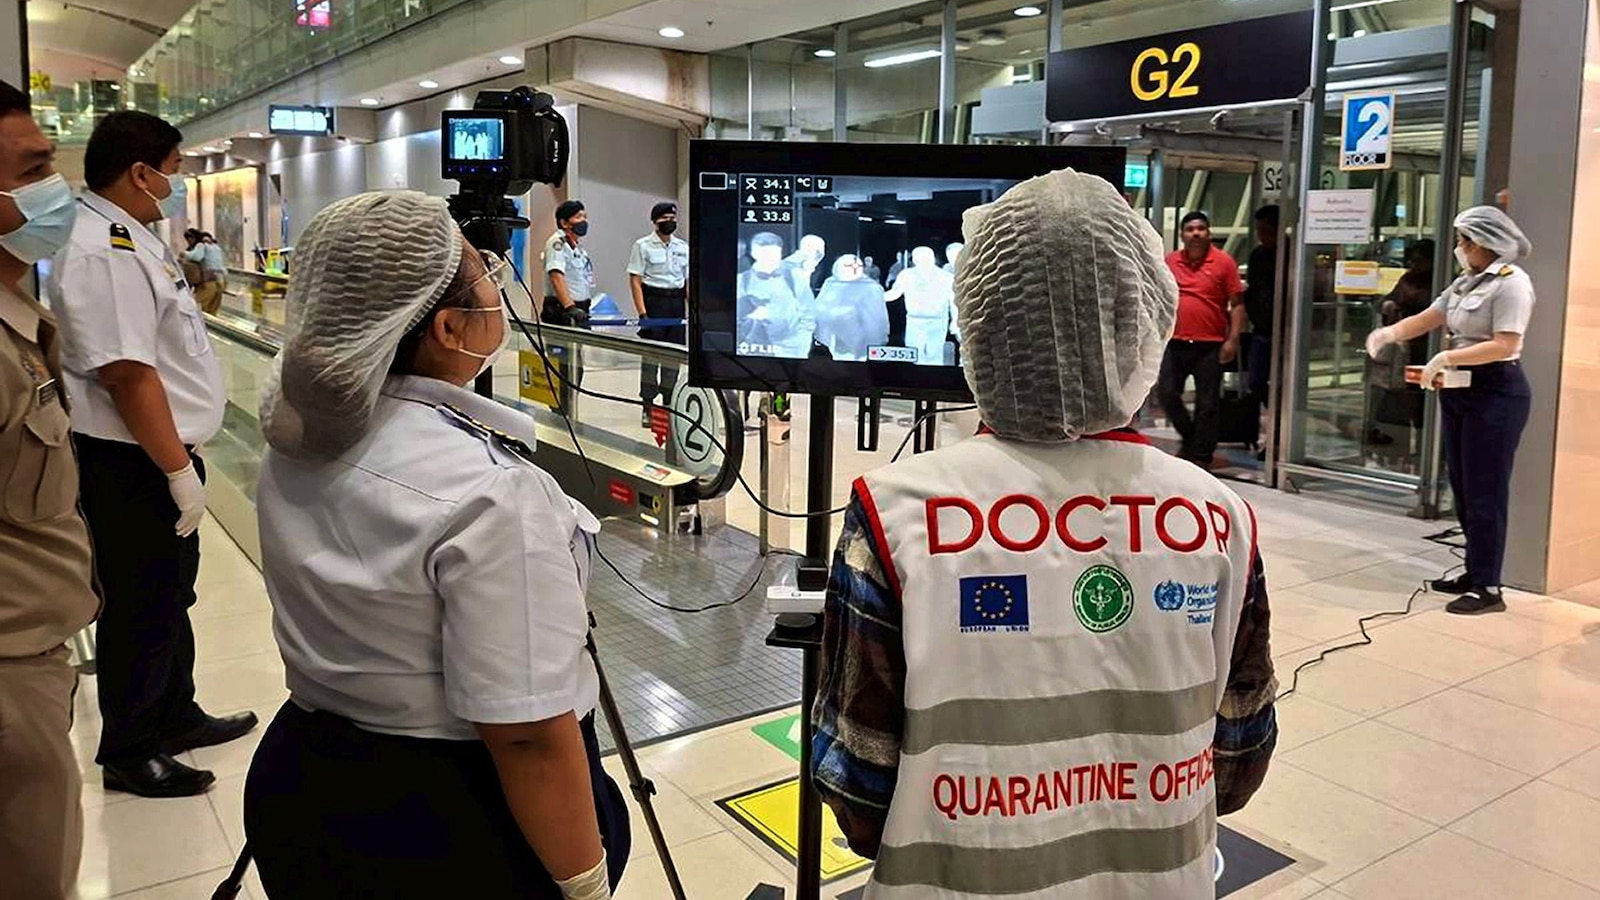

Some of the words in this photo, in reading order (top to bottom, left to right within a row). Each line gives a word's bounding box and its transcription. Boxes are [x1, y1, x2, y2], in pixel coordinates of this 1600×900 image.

[1131, 42, 1200, 101] G2
[1357, 101, 1389, 152] 2
[763, 179, 790, 189] 34.1
[763, 194, 790, 205] 35.1
[762, 211, 791, 222] 33.8
[890, 350, 914, 359] 35.1
[686, 394, 704, 452] 2
[926, 494, 1231, 555] DOCTOR
[933, 762, 1137, 820] QUARANTINE
